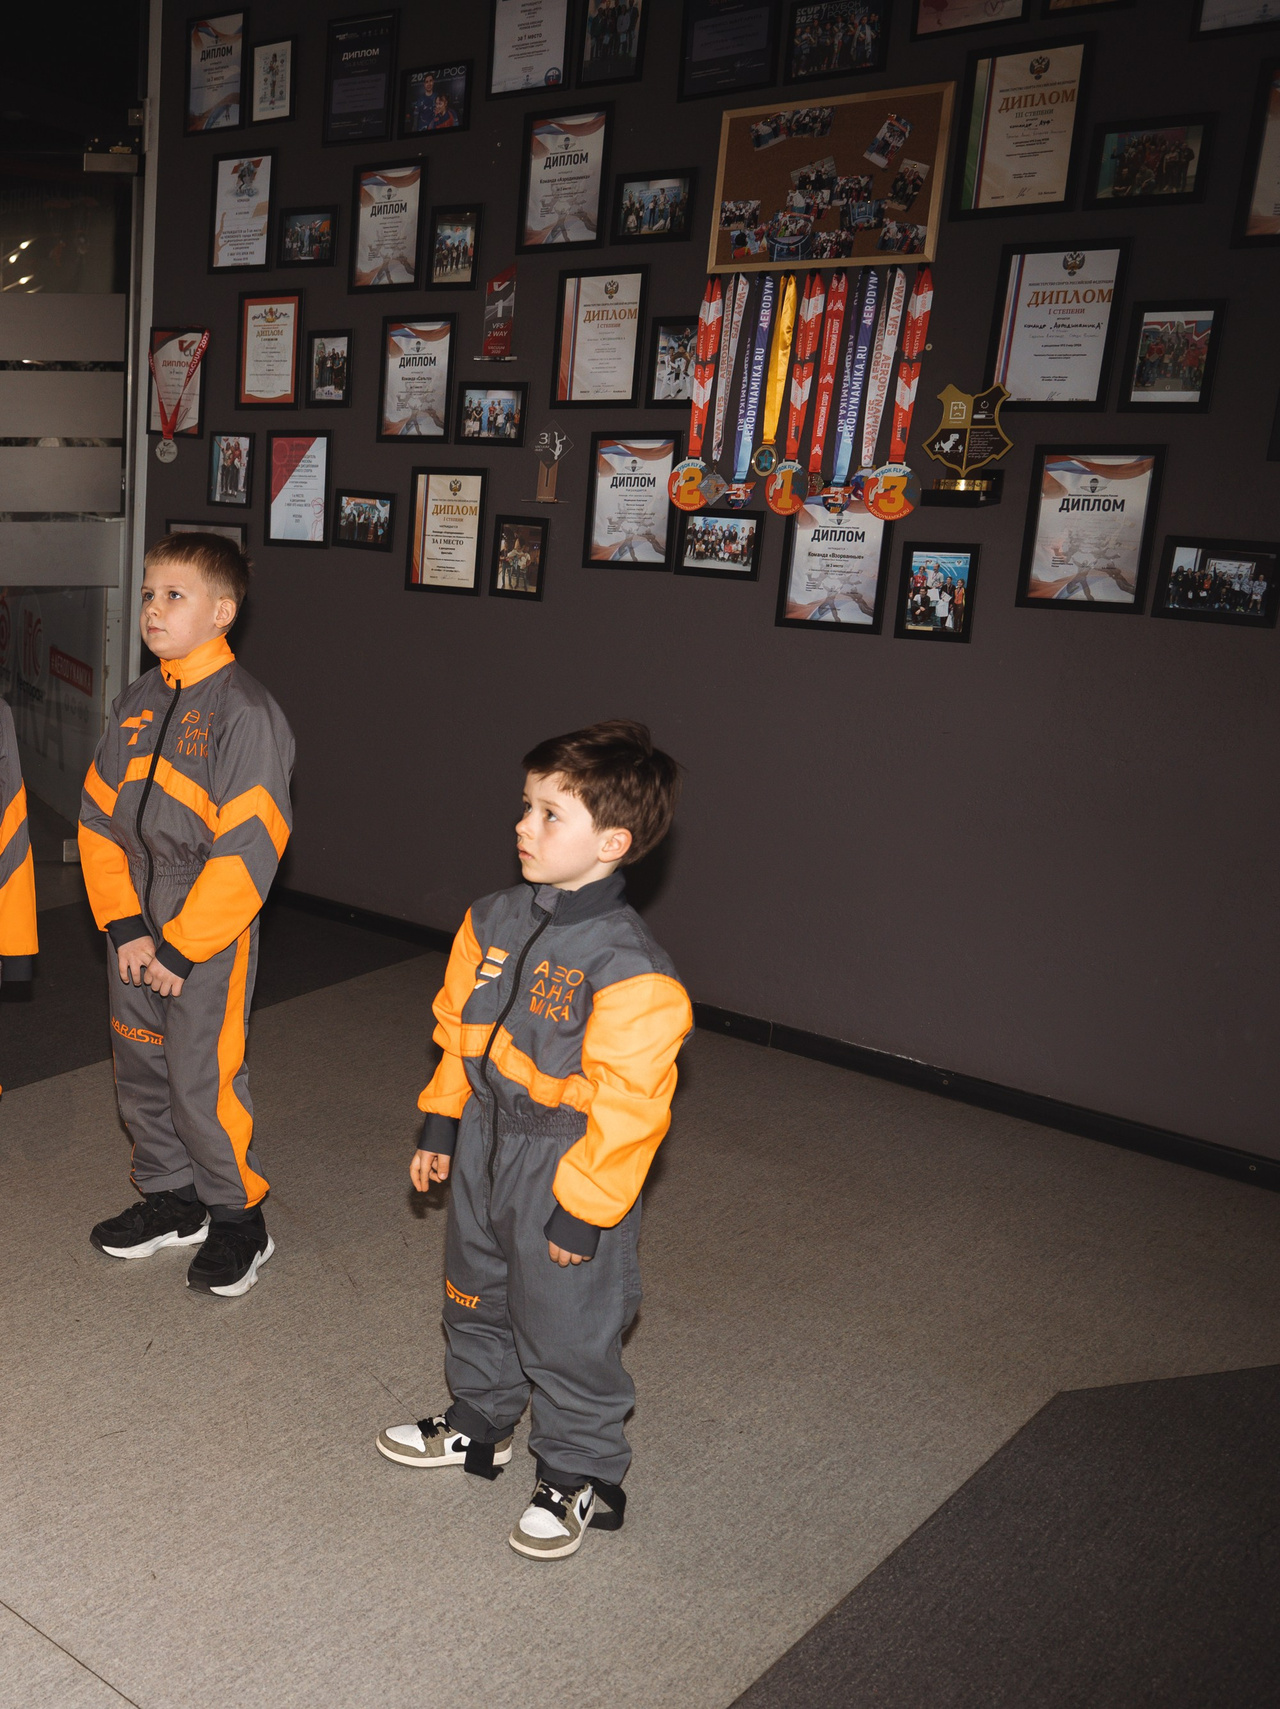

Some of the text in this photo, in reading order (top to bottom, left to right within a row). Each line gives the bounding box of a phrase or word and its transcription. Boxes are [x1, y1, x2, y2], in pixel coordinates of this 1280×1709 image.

[200, 45, 233, 62] ДИПЛОМ
[342, 48, 380, 61] ДИПЛОМ
[998, 88, 1076, 114] ДИПЛОМ
[1024, 109, 1054, 118] СТЕПЕНИ
[544, 152, 589, 170] ДИПЛОМ
[370, 202, 407, 217] ДИПЛОМ
[886, 272, 906, 336] 2-WAY VFS
[1027, 289, 1114, 308] ДИПЛОМ
[495, 299, 504, 318] 1
[583, 308, 638, 324] ДИПЛОМ
[732, 280, 748, 339] 2-WAY VFS
[399, 356, 437, 369] ДИПЛОМ
[744, 347, 765, 443] AERODYNAMIKA.RU
[843, 345, 868, 445] AERODYNAMIKA.RU
[816, 406, 827, 438] МОСКОВСКИЙ
[539, 432, 549, 445] 3
[610, 476, 656, 489] ДИПЛОМ
[679, 467, 703, 504] 2
[777, 470, 793, 509] 1
[730, 484, 746, 500] 3
[827, 487, 844, 503] 3
[878, 476, 908, 513] 3
[432, 504, 478, 516] ДИПЛОМ
[1058, 498, 1126, 513] ДИПЛОМ
[811, 529, 866, 543] ДИПЛОМ
[533, 960, 585, 987] АЭО
